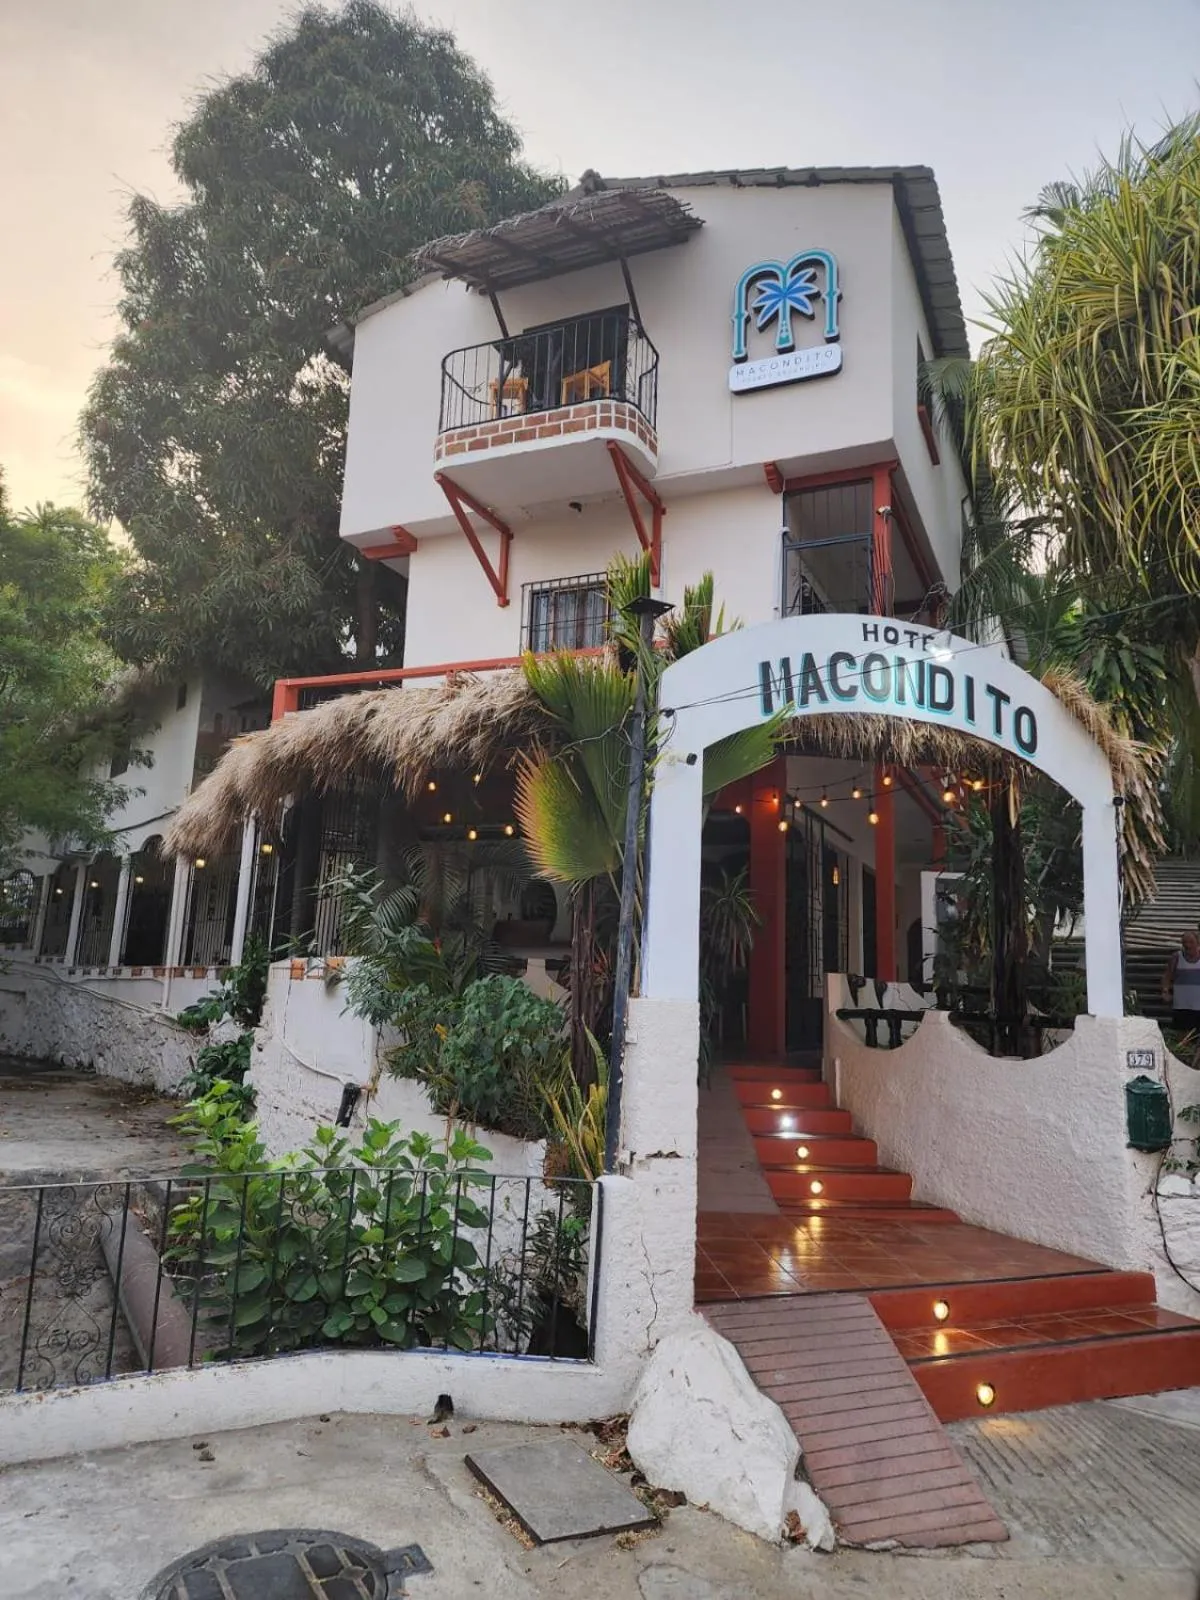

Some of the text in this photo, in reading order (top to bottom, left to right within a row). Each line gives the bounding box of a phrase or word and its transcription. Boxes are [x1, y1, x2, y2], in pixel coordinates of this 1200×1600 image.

[736, 350, 833, 377] MACONDITO
[862, 622, 935, 652] HOTE
[759, 651, 1037, 757] MACONDITO
[1130, 1054, 1151, 1065] 379
